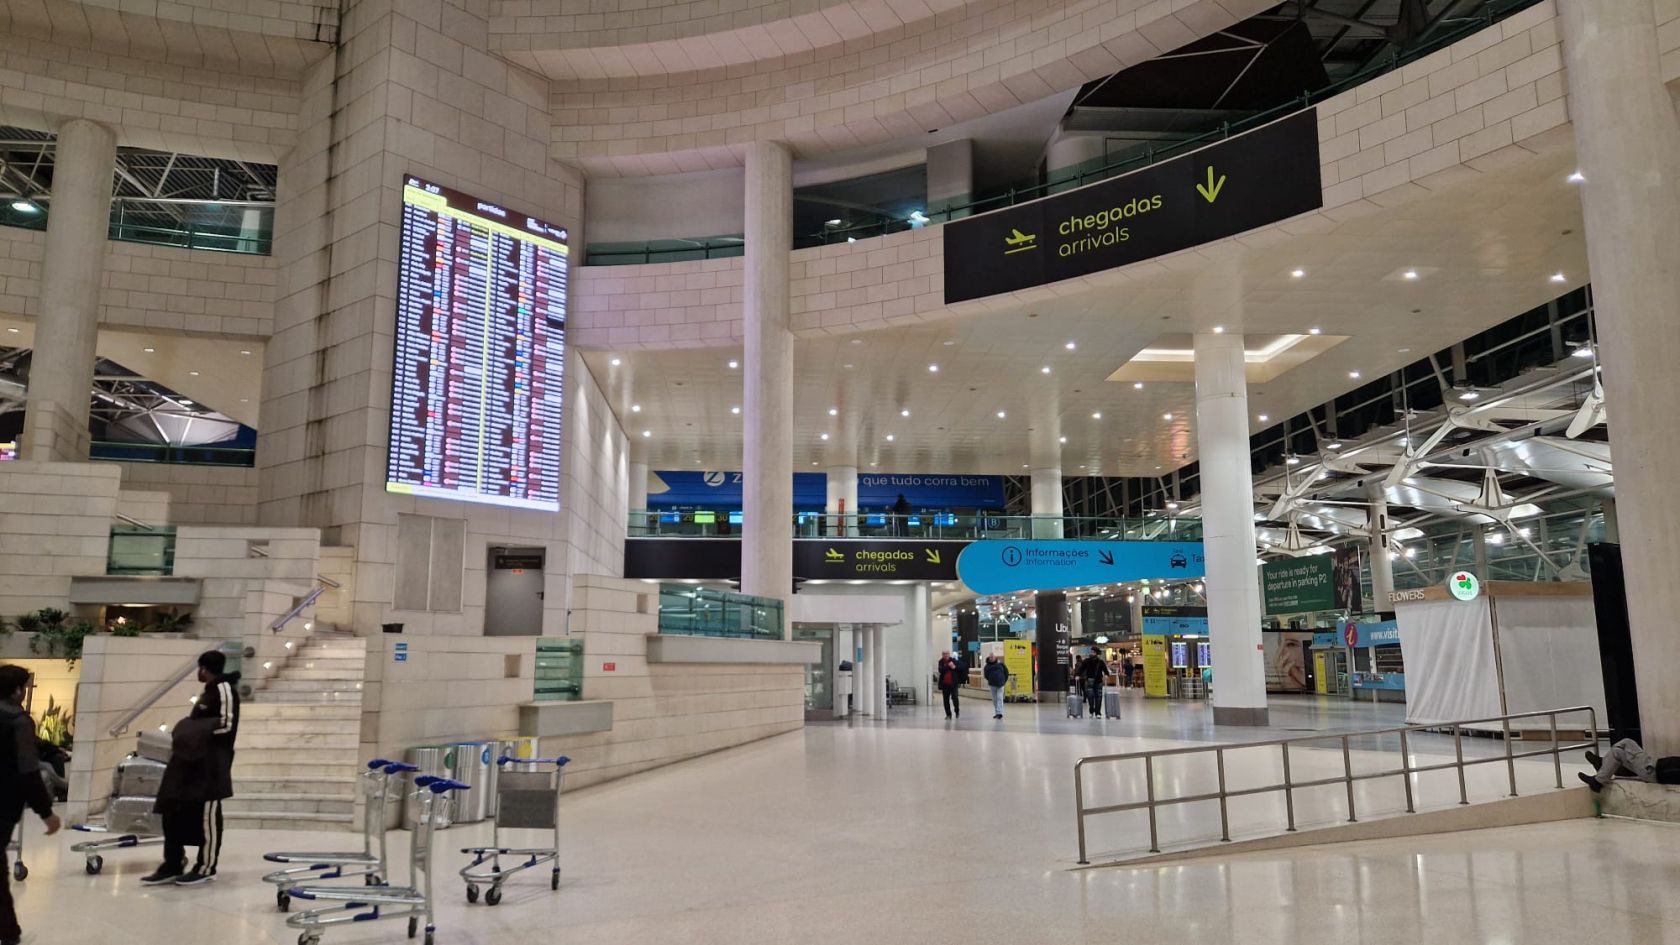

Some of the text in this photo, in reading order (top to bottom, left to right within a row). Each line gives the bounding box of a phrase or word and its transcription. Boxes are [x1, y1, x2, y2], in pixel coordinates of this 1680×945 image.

[1058, 193, 1162, 236] chegadas
[1058, 225, 1130, 257] arrivals
[863, 475, 989, 487] que tudo corra bem
[855, 549, 914, 562] chegadas
[1026, 548, 1089, 559] Informações
[855, 562, 896, 572] arrivals
[1026, 558, 1077, 566] Information
[1267, 571, 1278, 580] Your
[1278, 569, 1288, 578] ride
[1294, 565, 1309, 576] ready
[1310, 564, 1318, 573] for
[1267, 581, 1291, 592] departure
[1298, 576, 1318, 589] parking
[1318, 573, 1327, 584] P2
[1388, 589, 1425, 602] FLOWERS
